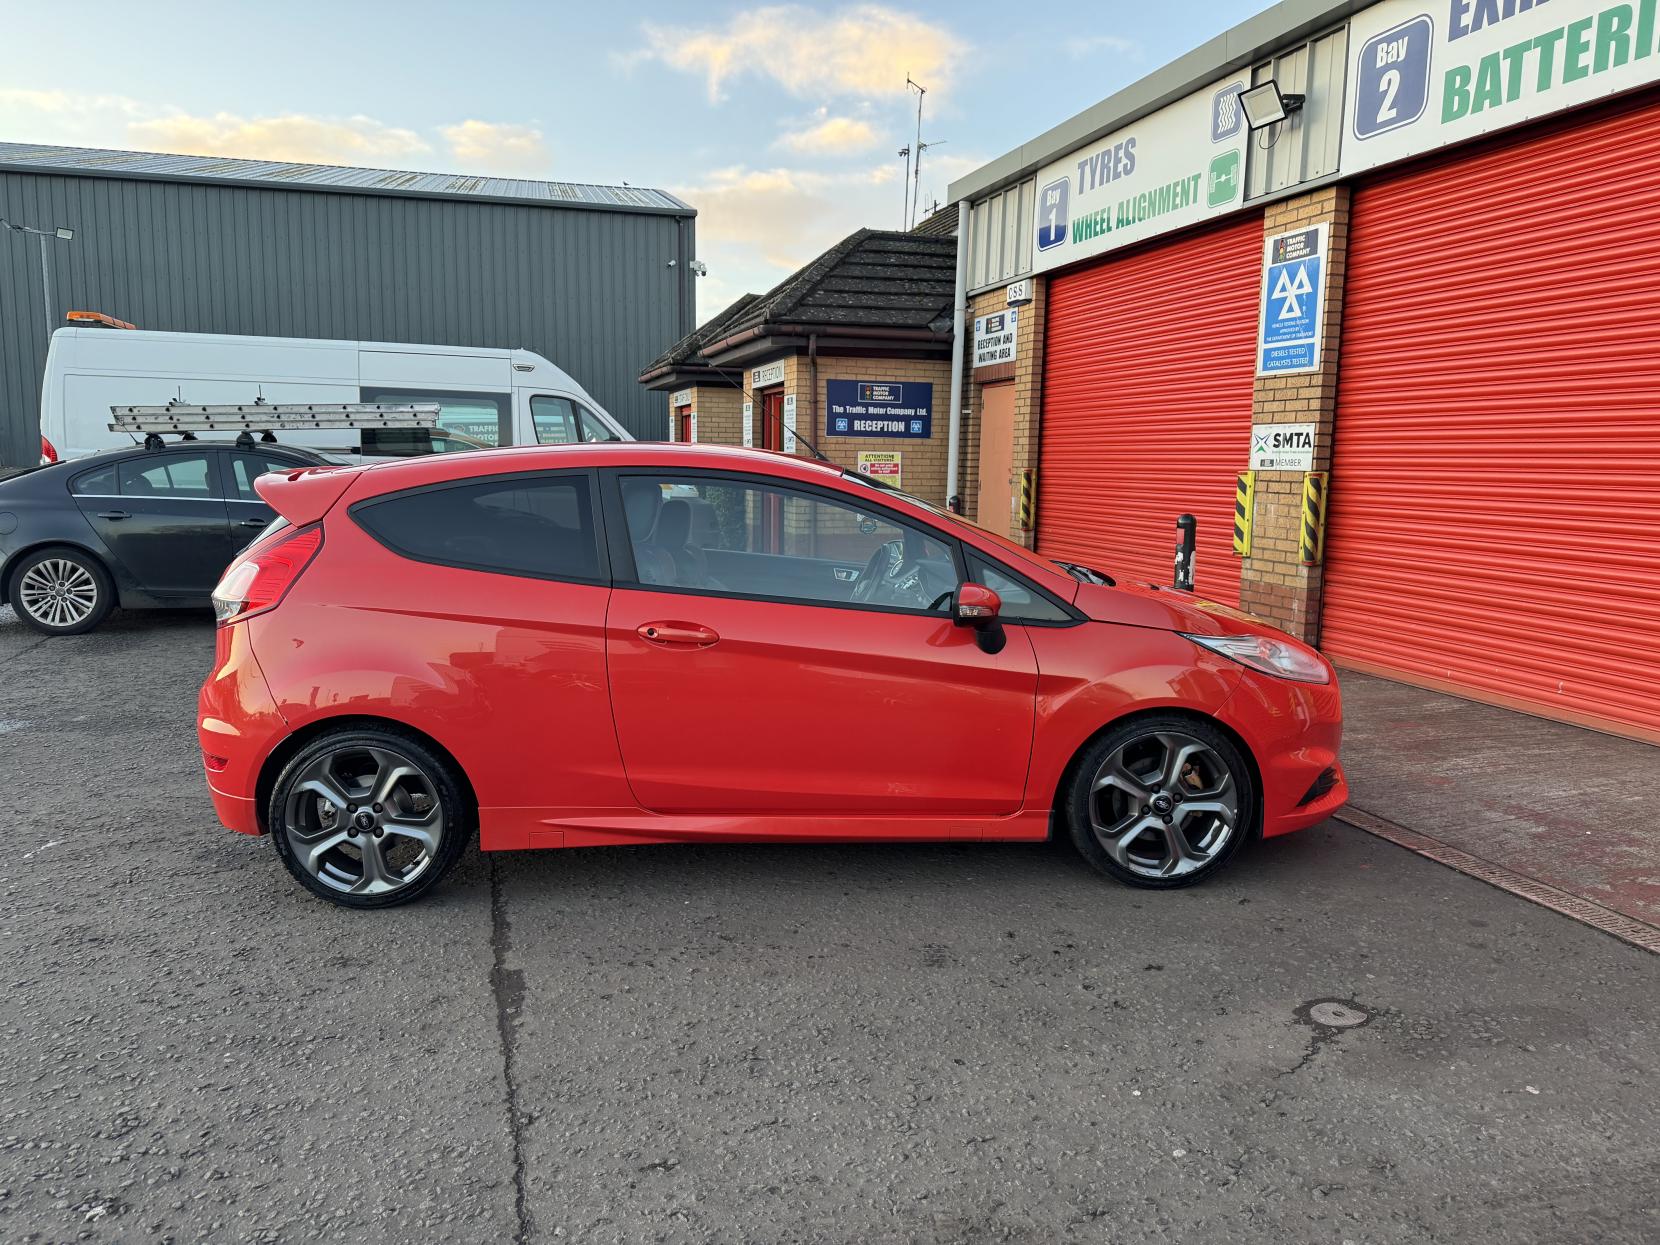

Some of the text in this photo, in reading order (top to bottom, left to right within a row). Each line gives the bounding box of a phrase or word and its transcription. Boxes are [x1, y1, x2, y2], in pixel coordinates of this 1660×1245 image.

[1376, 36, 1409, 68] Bay
[1441, 0, 1660, 124] BATTERI
[1376, 69, 1401, 124] 2
[1077, 137, 1137, 195] TYRES
[1046, 188, 1061, 207] Bay
[1072, 172, 1202, 245] WHEEL ALIGNMENT
[1048, 206, 1057, 241] 1
[1286, 234, 1306, 246] TRAFFIC
[1286, 242, 1304, 252] MOTOR
[1286, 247, 1311, 259] COMPANY
[978, 333, 1012, 350] RECEPTION AND
[978, 348, 1010, 363] WAITING AREA
[1270, 347, 1306, 358] DIESELS TESTED
[1267, 357, 1309, 368] CATALYSTS TESTED
[762, 365, 783, 382] RECEPTION
[832, 405, 928, 416] The Traffic Motor Company Ltd.
[853, 420, 905, 432] RECEPTION
[1272, 432, 1312, 448] SMTA
[1275, 458, 1302, 467] MEMBER
